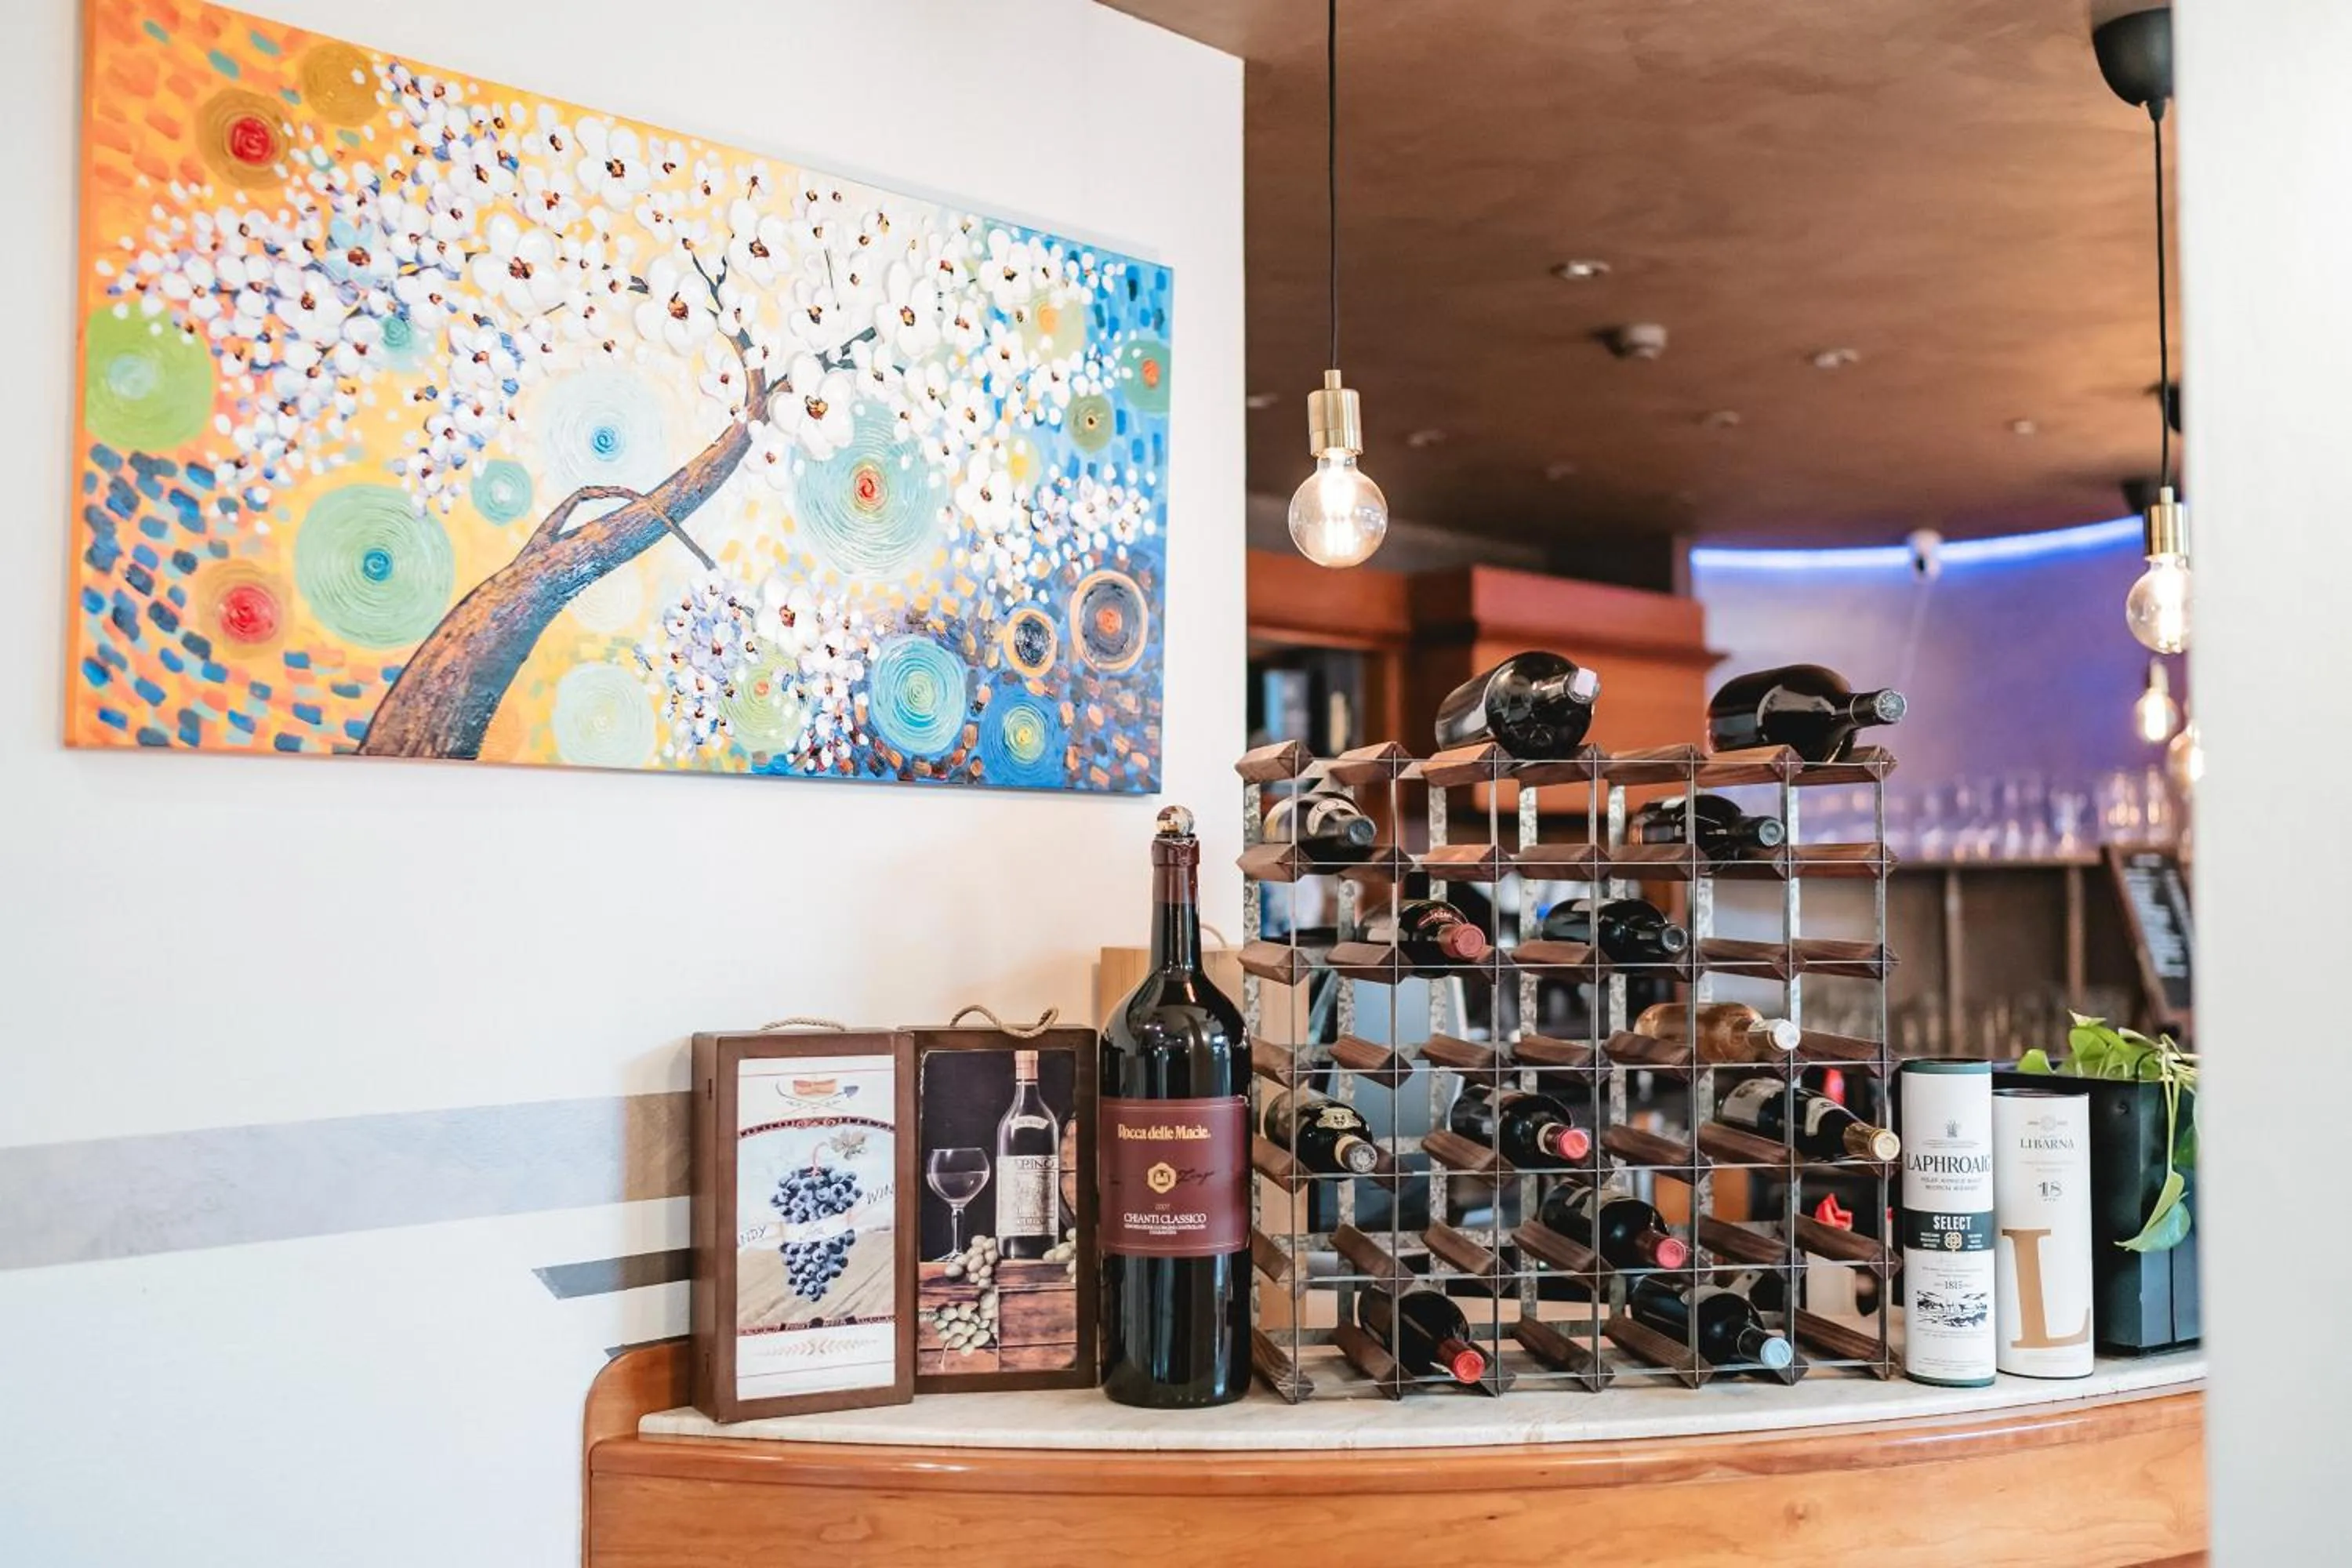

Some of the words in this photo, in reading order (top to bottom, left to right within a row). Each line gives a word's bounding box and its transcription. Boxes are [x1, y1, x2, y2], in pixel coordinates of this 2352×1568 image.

[1118, 1123, 1146, 1140] Rocca
[1147, 1126, 1173, 1139] delle
[2020, 1138, 2074, 1149] LIBARNA
[2038, 1181, 2063, 1197] 18
[1123, 1213, 1160, 1224] CHIANTI
[1160, 1214, 1207, 1224] CLASSICO
[1933, 1215, 1972, 1230] SELECT
[2002, 1229, 2091, 1348] L
